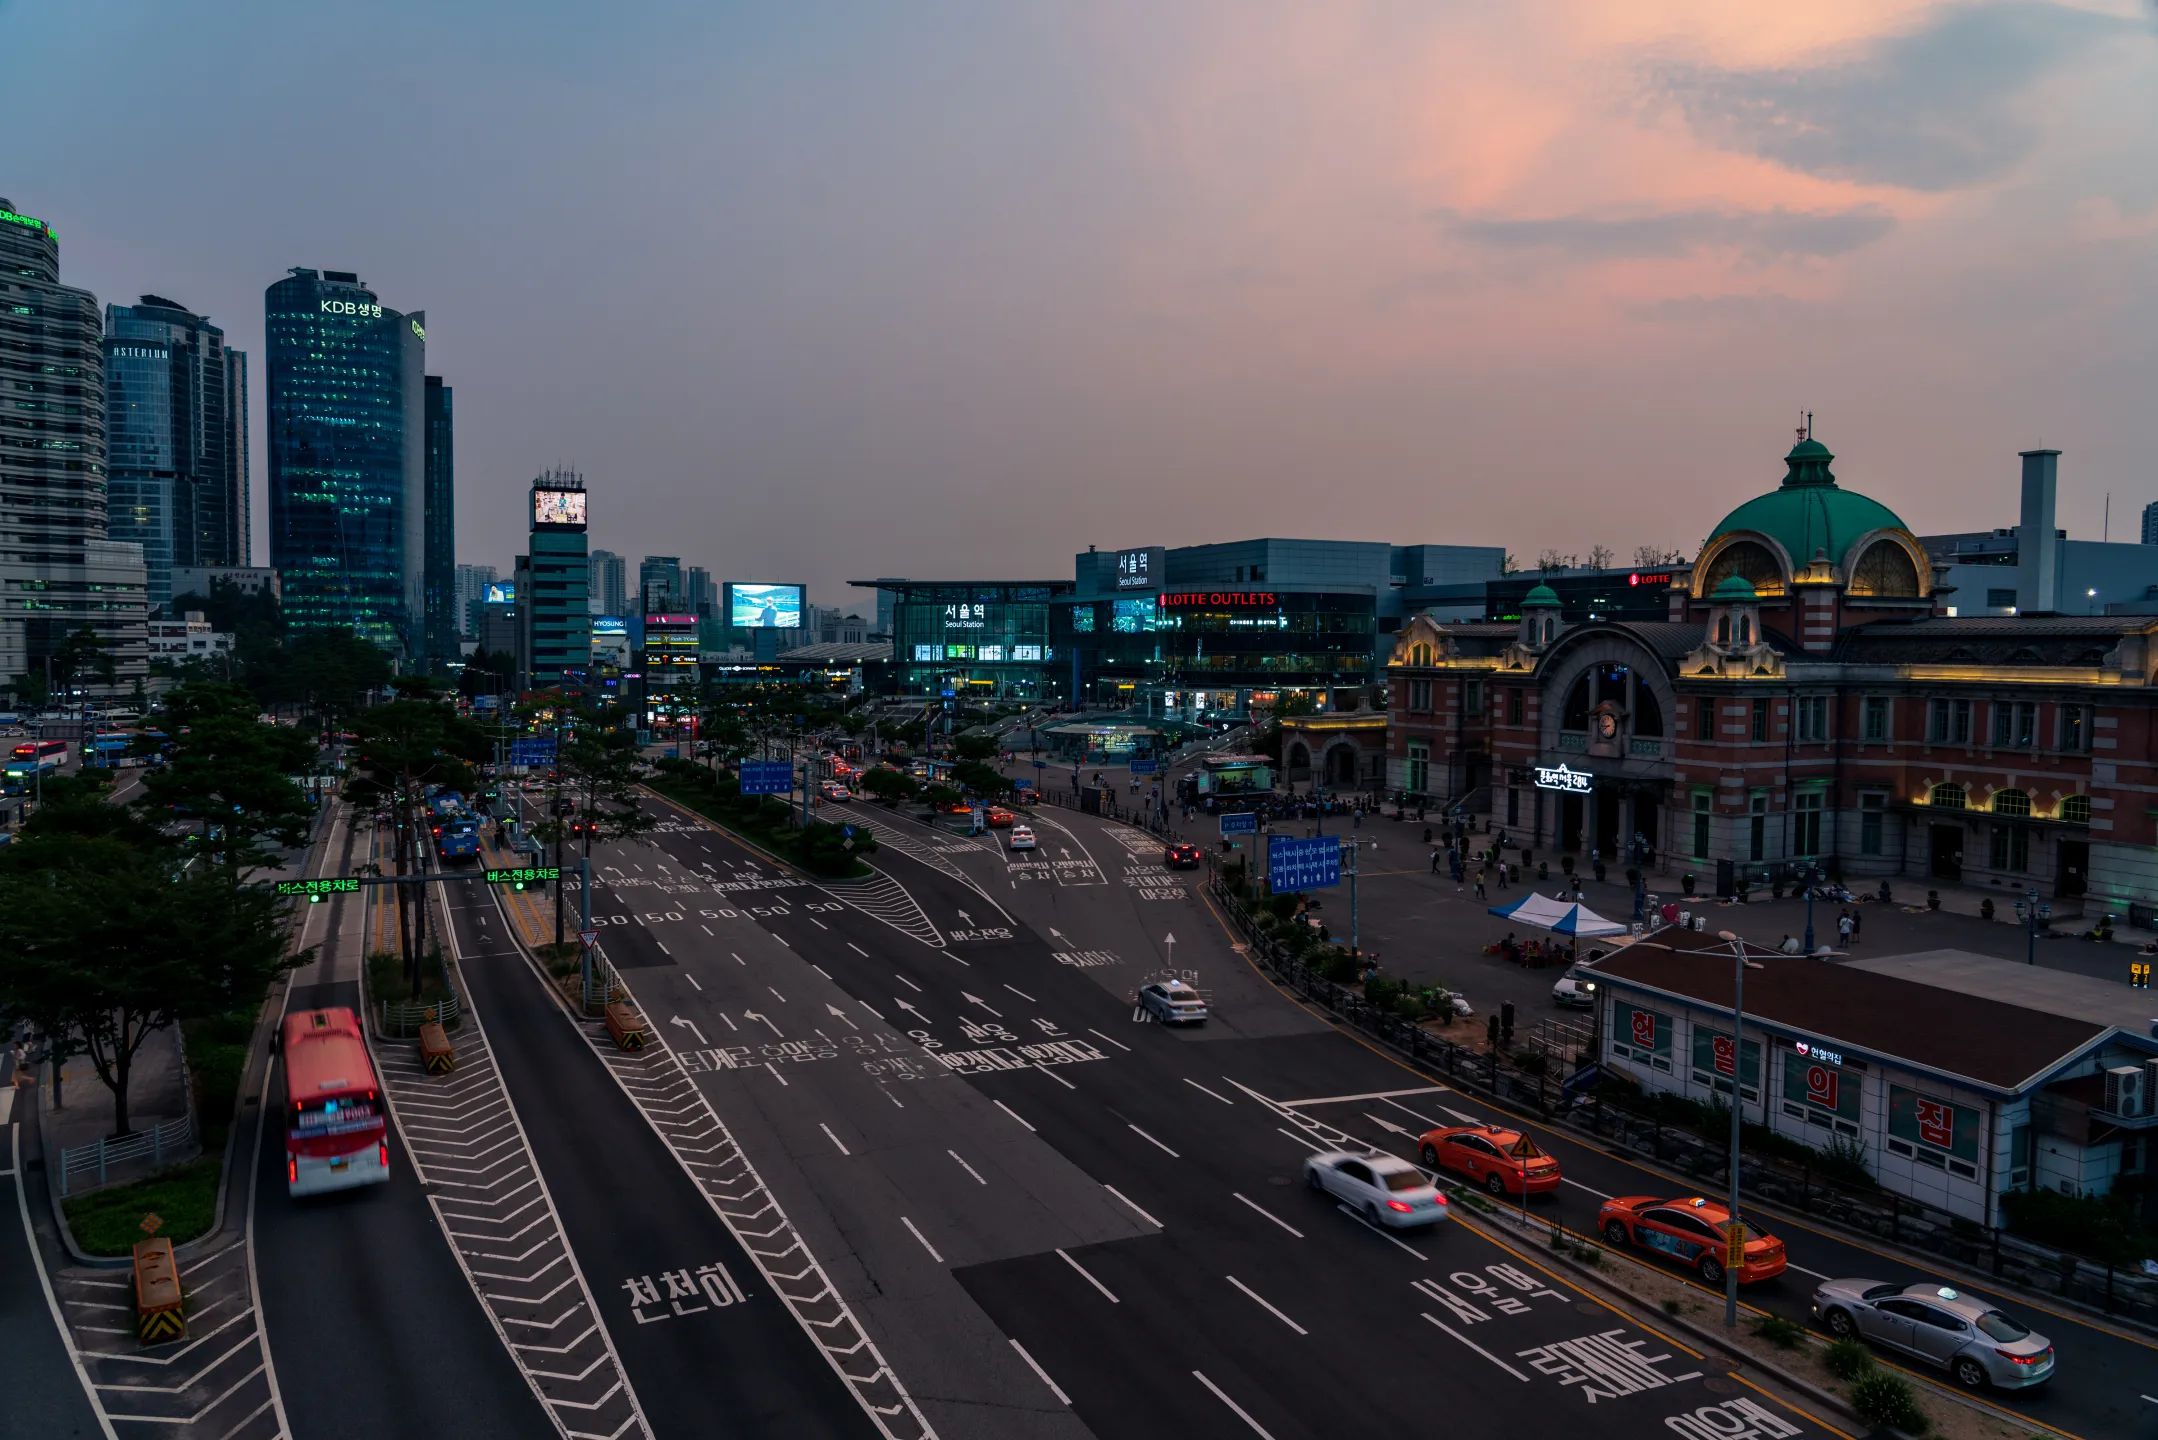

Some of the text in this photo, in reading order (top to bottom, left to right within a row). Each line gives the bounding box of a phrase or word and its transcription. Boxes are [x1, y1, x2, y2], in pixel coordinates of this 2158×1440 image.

[321, 299, 382, 318] KDB생명
[113, 347, 168, 359] ASTERIUM
[1119, 553, 1148, 574] 서울역
[1119, 575, 1148, 586] Seoul Station
[1641, 574, 1671, 584] LOTTE
[1168, 593, 1275, 606] LOTTE OUTLETS
[945, 603, 985, 619] 서울역
[945, 620, 985, 628] Seoul Station
[1285, 849, 1297, 857] 택시
[487, 868, 560, 882] 버스전용차로
[1273, 866, 1284, 874] 전용
[699, 908, 738, 919] 50
[751, 905, 791, 917] 50
[804, 902, 844, 913] 50
[590, 915, 628, 927] 50
[645, 911, 684, 923] 50
[949, 927, 1014, 941] 버스전용
[677, 1046, 763, 1073] 퇴계로
[1017, 1040, 1110, 1066] 한강대교
[939, 1047, 1033, 1075] 한강대교
[1805, 1065, 1839, 1112] 의
[1914, 1097, 1954, 1151] 집
[621, 1261, 747, 1325] 천천히
[1410, 1263, 1571, 1325] 서울역
[1516, 1328, 1704, 1404] 롯데마트
